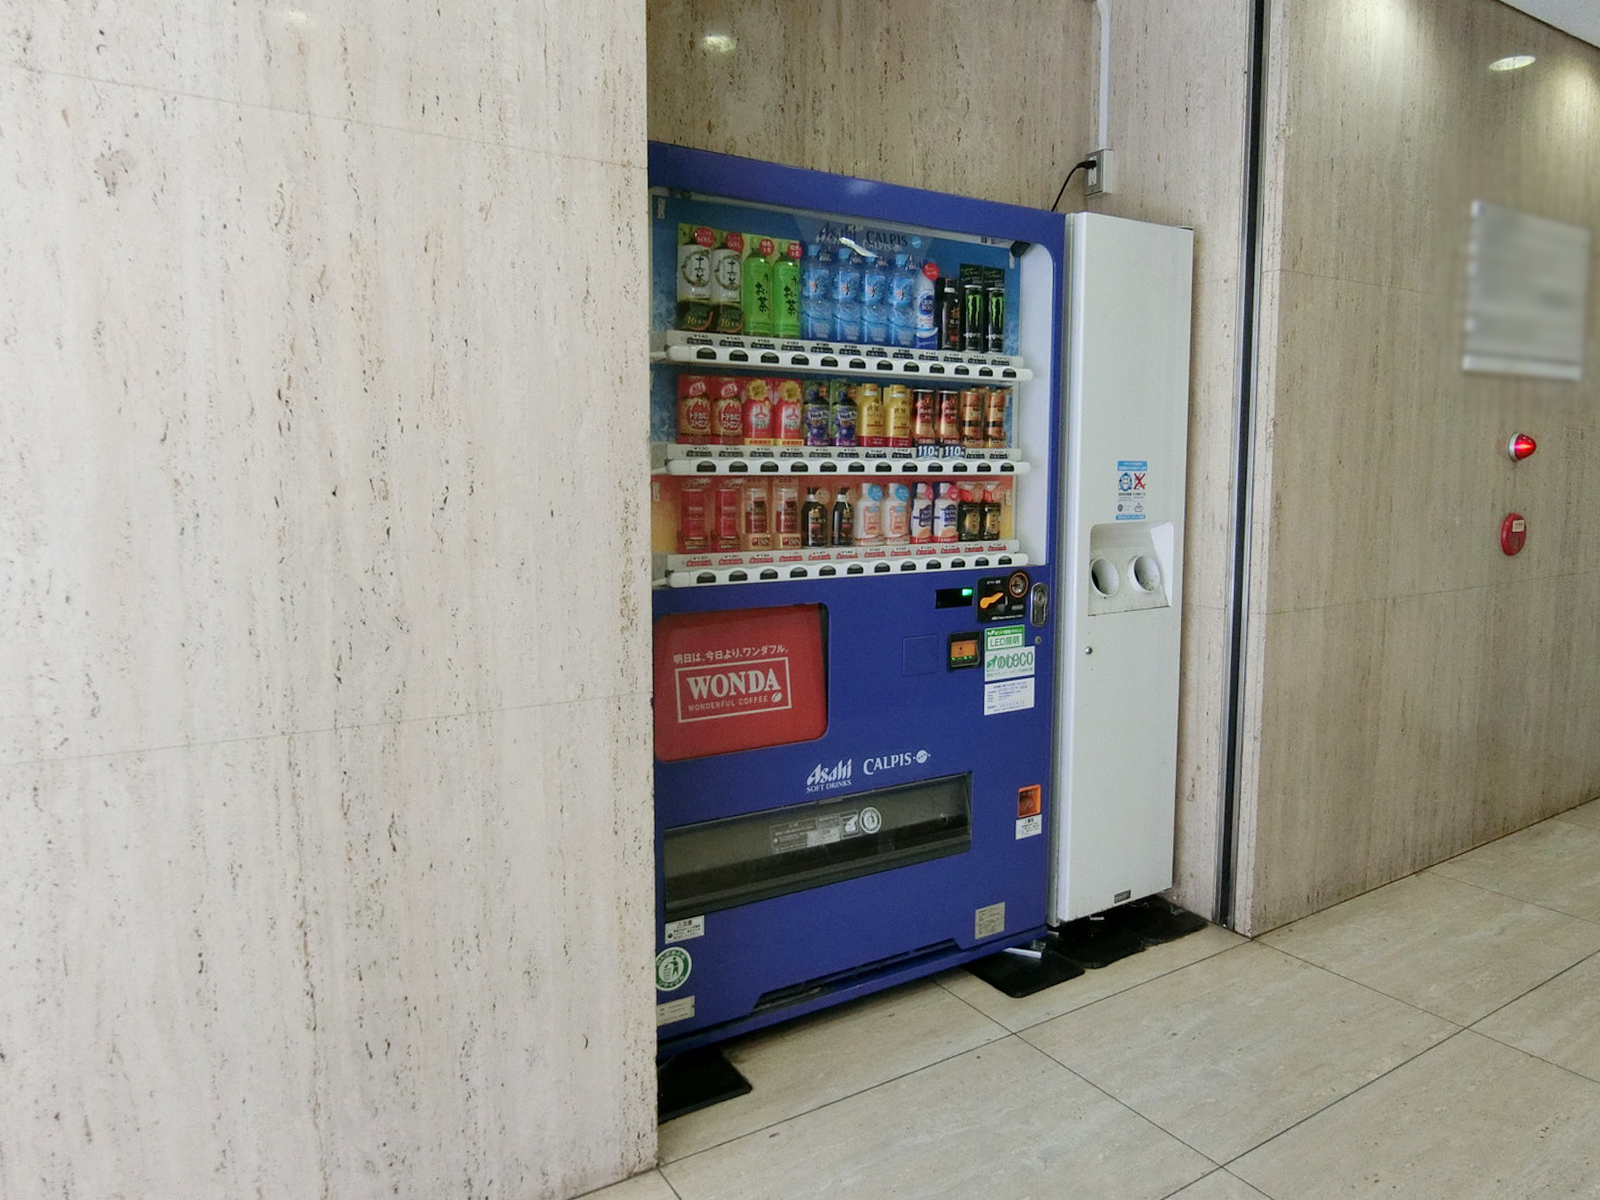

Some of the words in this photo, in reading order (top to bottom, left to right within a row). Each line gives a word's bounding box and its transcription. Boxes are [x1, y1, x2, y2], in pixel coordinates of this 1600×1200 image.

[673, 644, 789, 665] 明日は、今日より、ワンダフル。
[686, 667, 781, 700] WONDA
[688, 700, 736, 712] WONDERFUL
[738, 695, 768, 706] COFFEE
[806, 758, 853, 786] Asahi
[862, 752, 912, 776] CALPIS
[806, 783, 824, 793] SOFT
[825, 780, 852, 790] DRINKS
